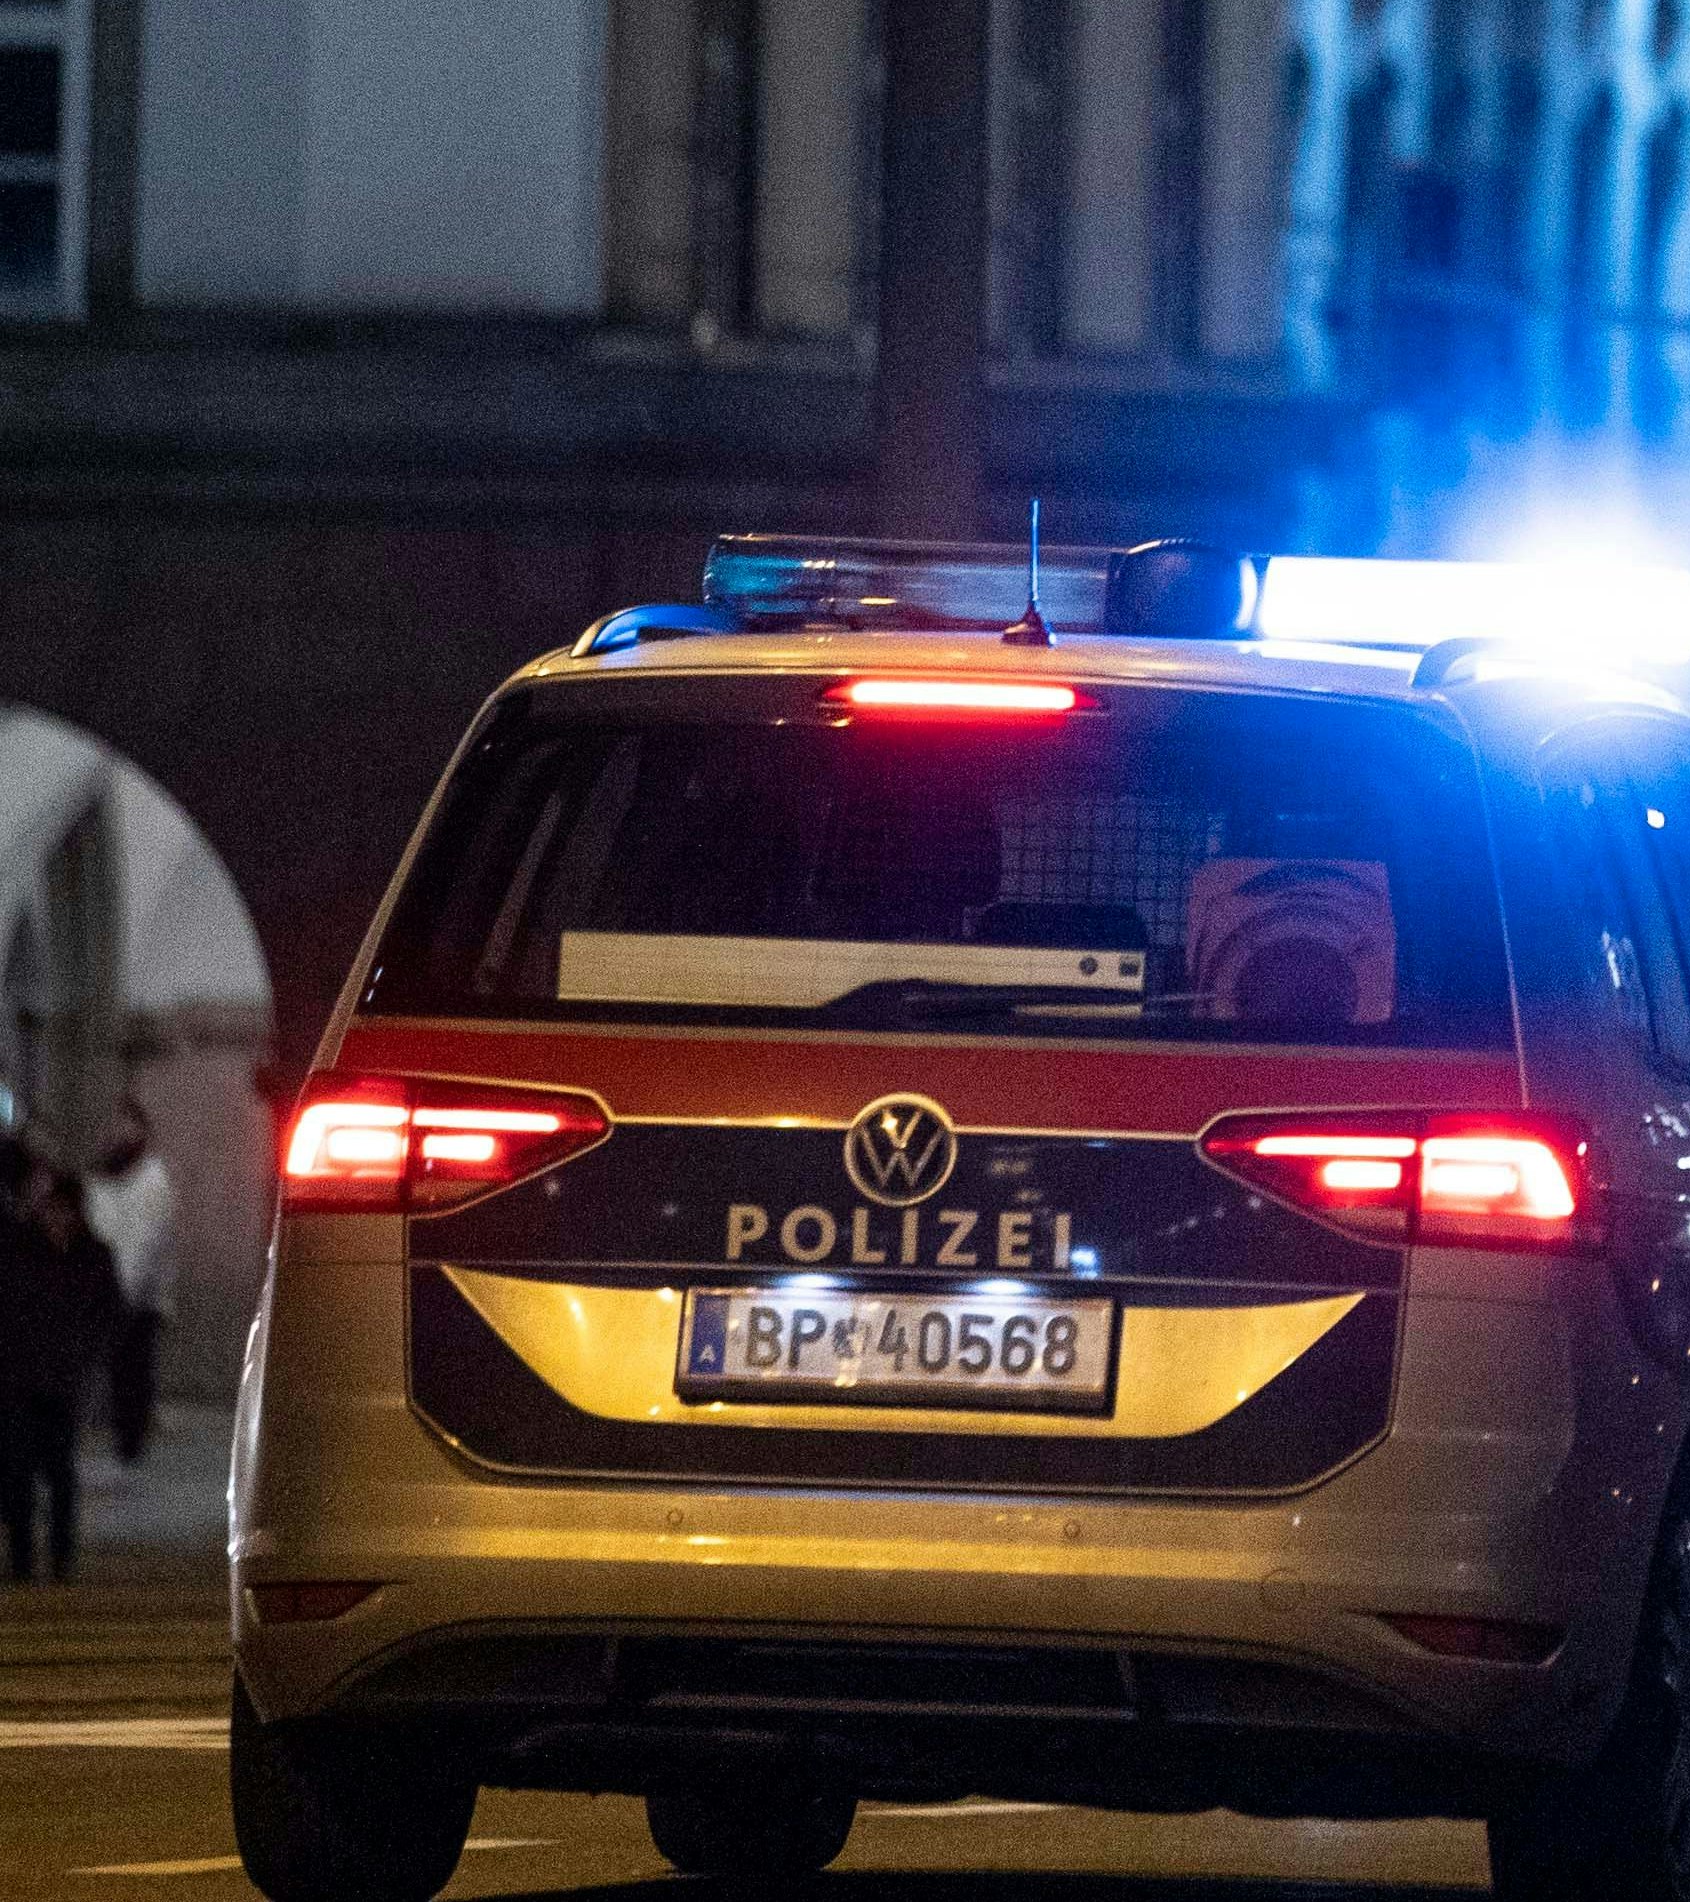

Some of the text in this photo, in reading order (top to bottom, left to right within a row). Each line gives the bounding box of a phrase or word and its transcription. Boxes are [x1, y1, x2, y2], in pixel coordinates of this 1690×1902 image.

[725, 1203, 1072, 1269] POLIZEI
[744, 1305, 827, 1371] BP
[875, 1308, 1078, 1376] 40568
